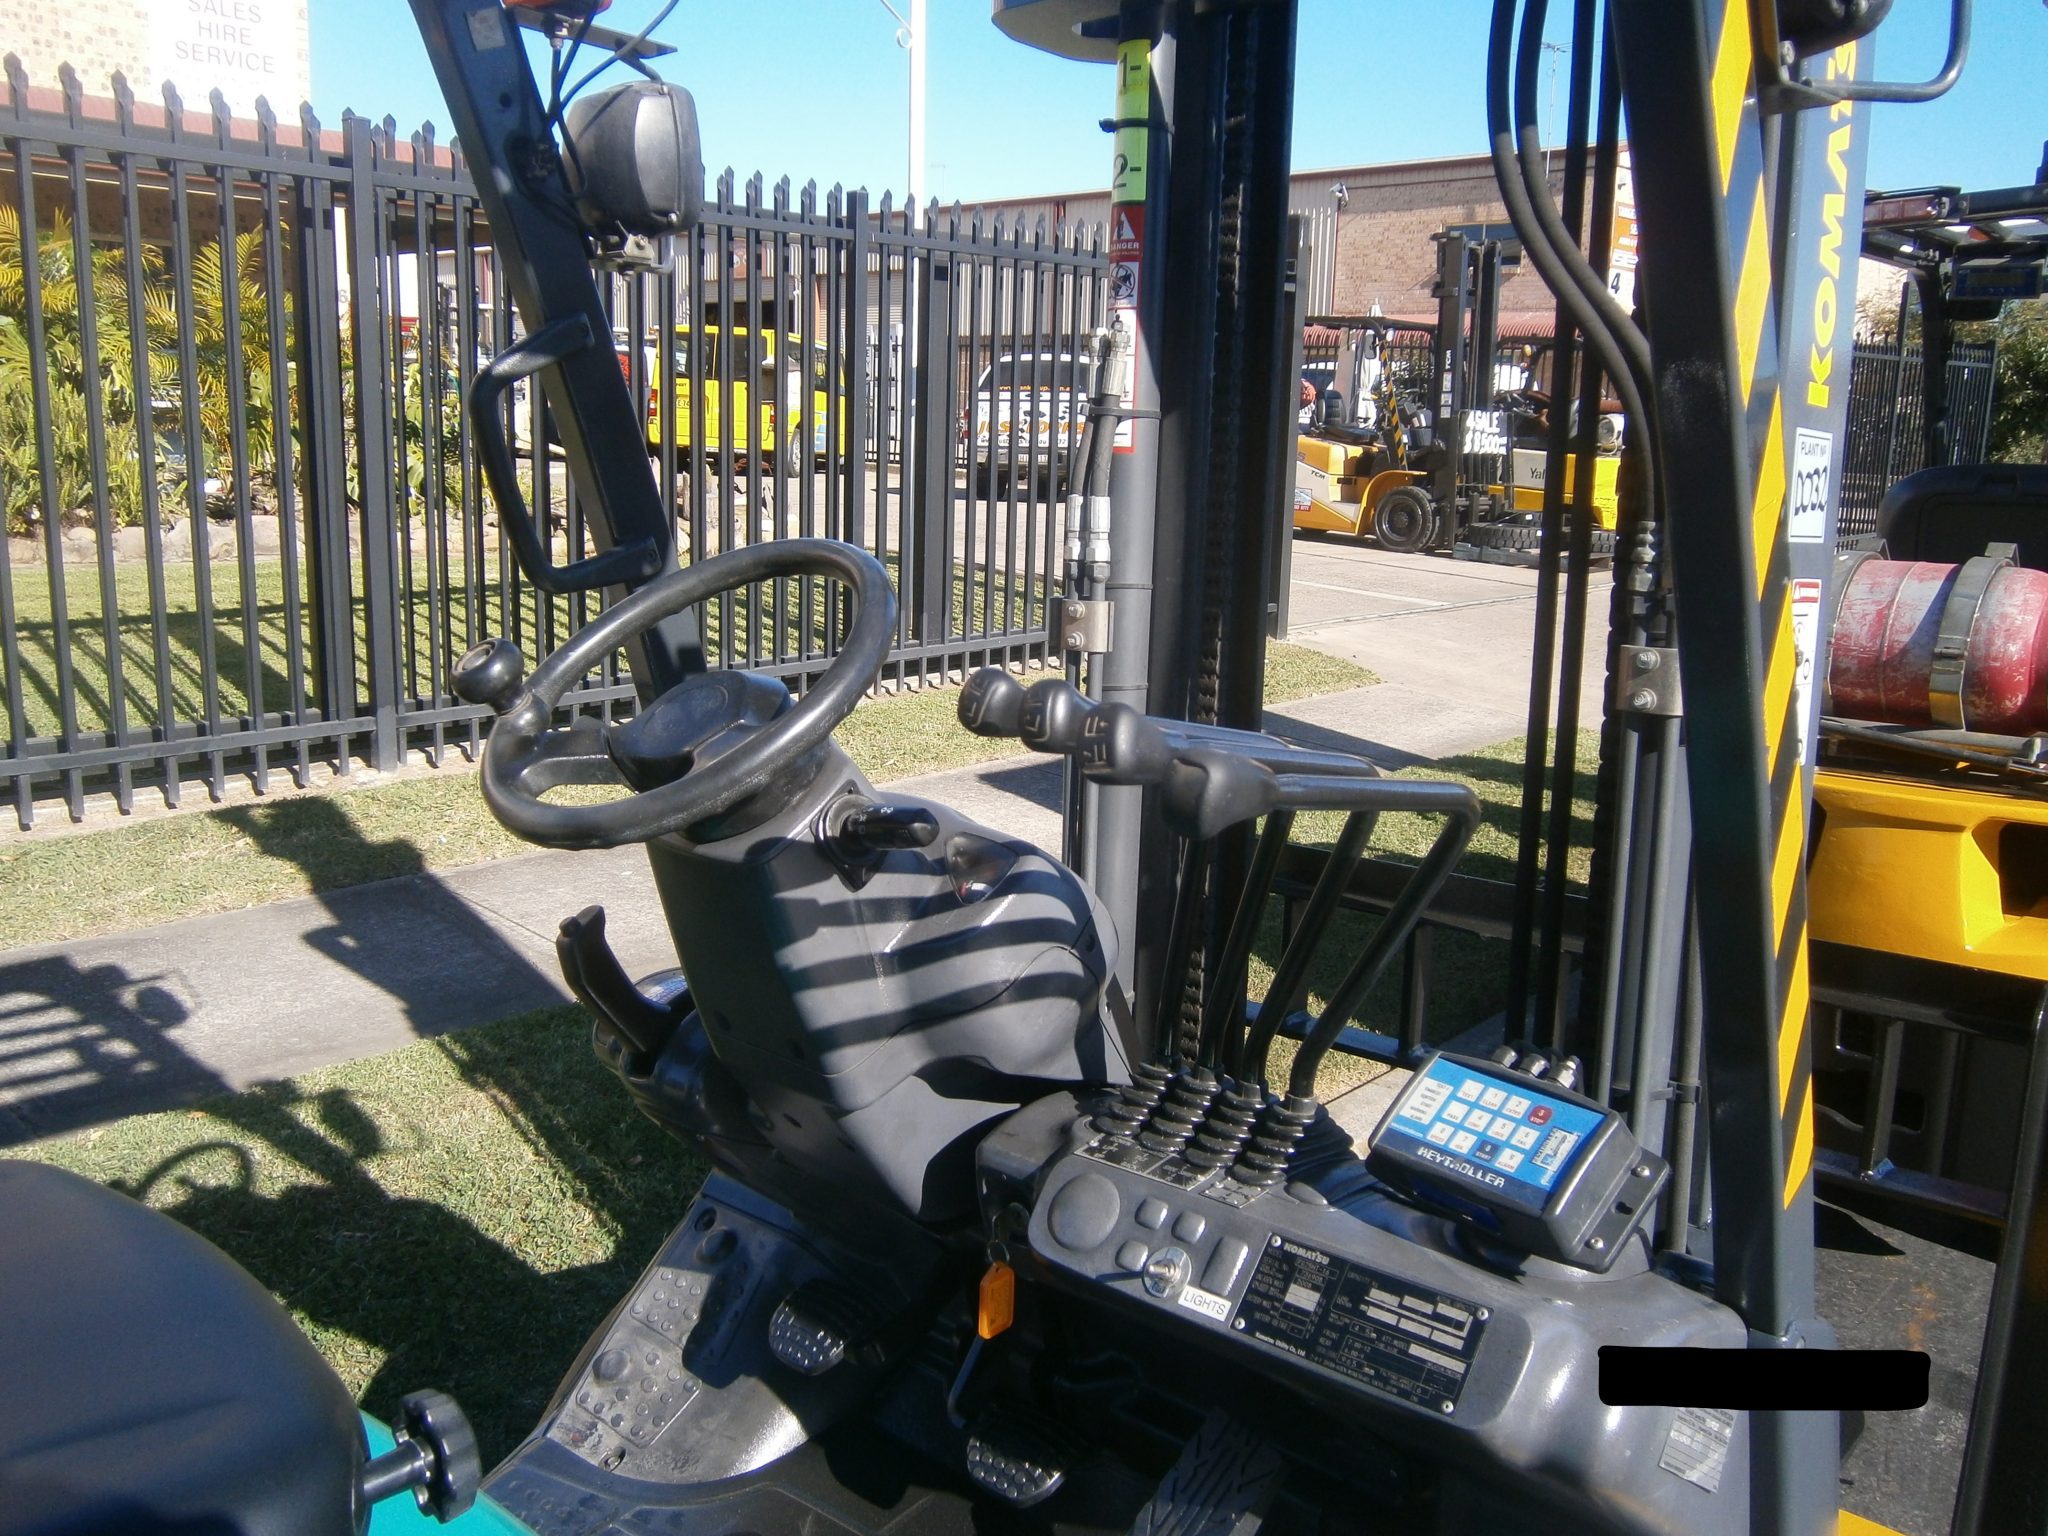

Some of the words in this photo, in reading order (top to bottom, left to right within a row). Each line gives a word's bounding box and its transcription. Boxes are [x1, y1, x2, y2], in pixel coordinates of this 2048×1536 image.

[187, 0, 262, 24] SALES
[198, 20, 253, 46] HIRE
[175, 40, 276, 74] SERVICE
[1800, 440, 1819, 457] PLANT
[1283, 1242, 1330, 1265] KOMATSU
[1183, 1290, 1227, 1316] LIGHTS
